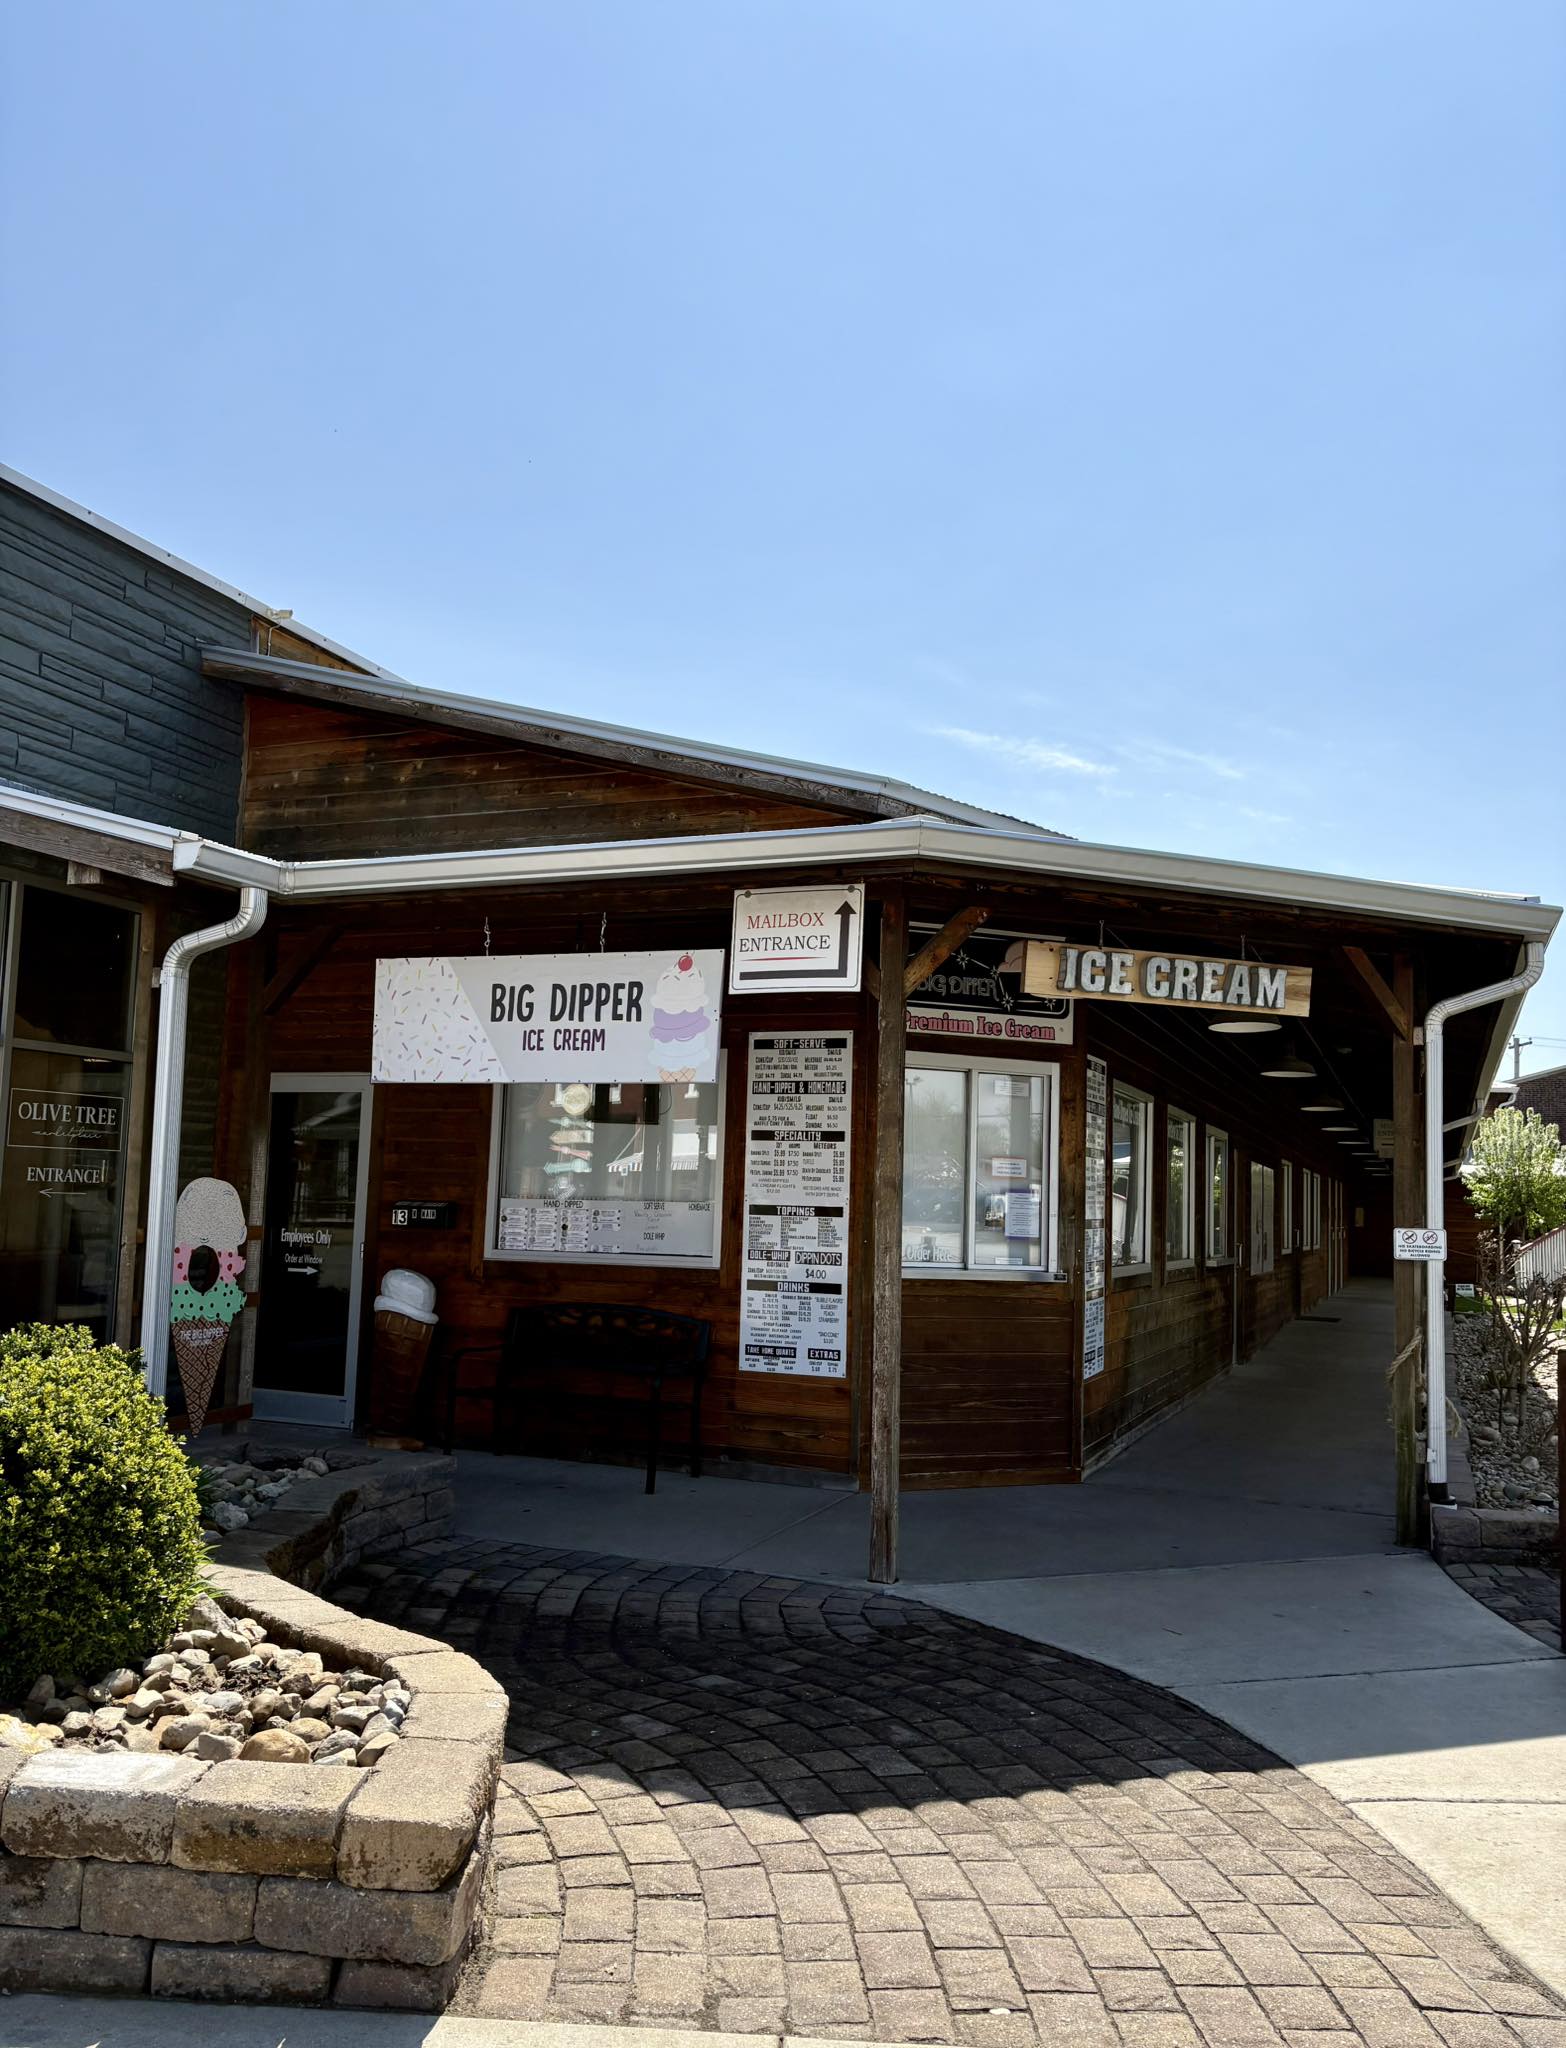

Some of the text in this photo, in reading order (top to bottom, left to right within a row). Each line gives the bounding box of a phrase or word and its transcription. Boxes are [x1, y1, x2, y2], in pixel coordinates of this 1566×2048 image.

[747, 912, 824, 929] MAILBOX
[740, 935, 830, 952] ENTRANCE
[1057, 948, 1287, 1008] ICE CREAM
[490, 981, 644, 1022] BIG DIPPER
[977, 1015, 1002, 1035] Ice
[1005, 1018, 1055, 1039] Cream
[522, 1029, 605, 1051] ICE CREAM
[774, 1039, 826, 1048] SOFT-SERVE
[753, 1082, 844, 1093] HAND-DIPPED & HOMEMADE
[18, 1102, 116, 1125] OLIVE TREE
[774, 1131, 821, 1141] SPECIALITY
[27, 1167, 100, 1183] ENTRANCE
[394, 1210, 406, 1223] 13
[777, 1206, 815, 1216] TOPPINGS
[281, 1228, 332, 1248] Employees Only
[285, 1254, 298, 1263] Order
[304, 1255, 322, 1264] Window
[750, 1250, 789, 1260] DOLE-WHIP
[821, 1253, 841, 1265] DOTS
[806, 1269, 826, 1279] $4.00
[778, 1282, 810, 1292] DRINKS
[810, 1350, 838, 1359] EXTRAS
